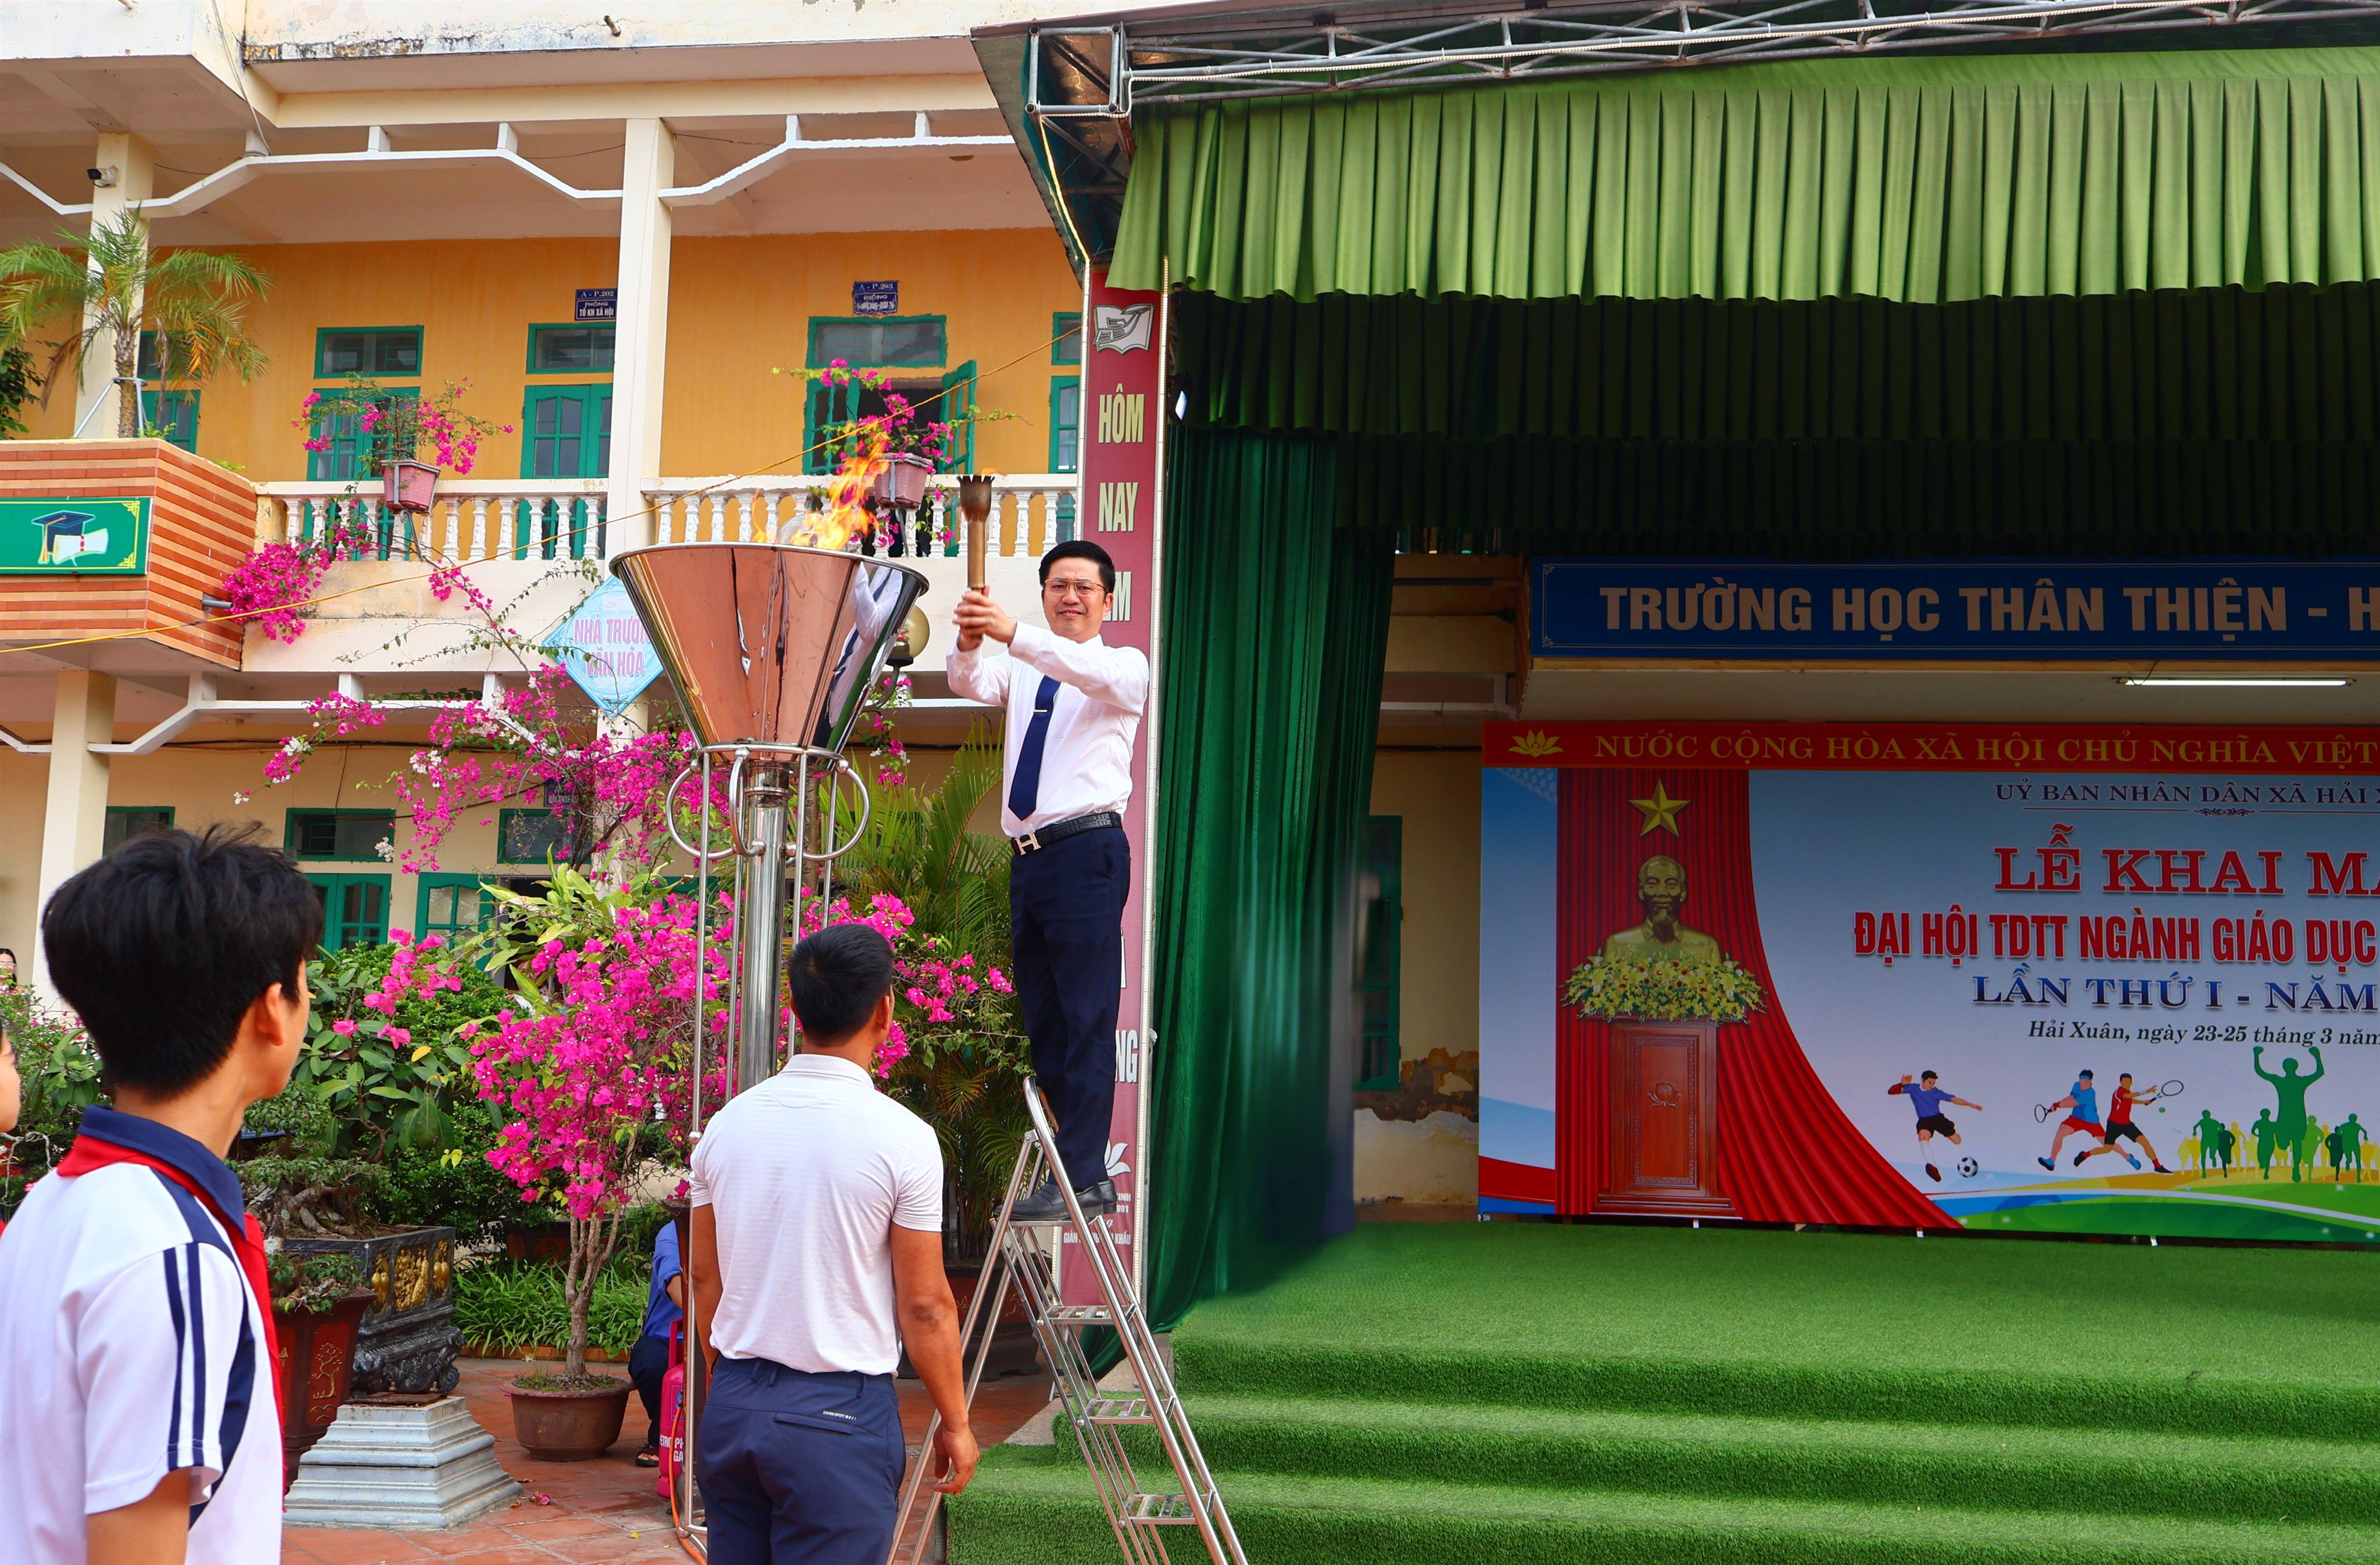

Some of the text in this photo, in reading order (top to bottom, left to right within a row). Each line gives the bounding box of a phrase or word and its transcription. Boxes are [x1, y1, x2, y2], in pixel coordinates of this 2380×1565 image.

[604, 307, 614, 318] HỘI
[1098, 383, 1144, 444] HÔM
[1098, 482, 1139, 532] NAY
[1102, 571, 1132, 621] M
[1599, 577, 1812, 631] TRƯỜNG
[1832, 588, 1940, 641] HỌC
[1959, 578, 2104, 631] THÂN
[2123, 577, 2287, 641] THIỆN
[2307, 608, 2327, 616] -
[574, 614, 602, 644] NHÀ
[587, 646, 644, 676] VĂN HÓA
[1594, 729, 2378, 770] NƯỚC CỘNG HÒA XÃ HỘI CHỦ NGHĨA VIỆT
[1995, 777, 2033, 801] UỶ
[2041, 784, 2099, 802] BAN
[2109, 781, 2191, 802] NHÂN
[2199, 781, 2261, 803] DÂN
[2268, 783, 2307, 803] XÃ
[2316, 781, 2368, 803] HẢI
[1994, 823, 2081, 893] LỄ
[2101, 848, 2284, 896] KHAI
[1854, 904, 2377, 974] ĐẠI HỘI TDTT NGÀNH GIÁO DỤC
[1972, 962, 2071, 1007] LẦN
[2085, 971, 2193, 1008] THỨ
[2205, 980, 2223, 1008] I
[2265, 974, 2378, 1011] NĂM
[2028, 1020, 2380, 1047] Hải Xuân, ngày 23-25 tháng 3 năm
[1114, 1230, 1131, 1245] KHẤU
[673, 1451, 684, 1462] GA
